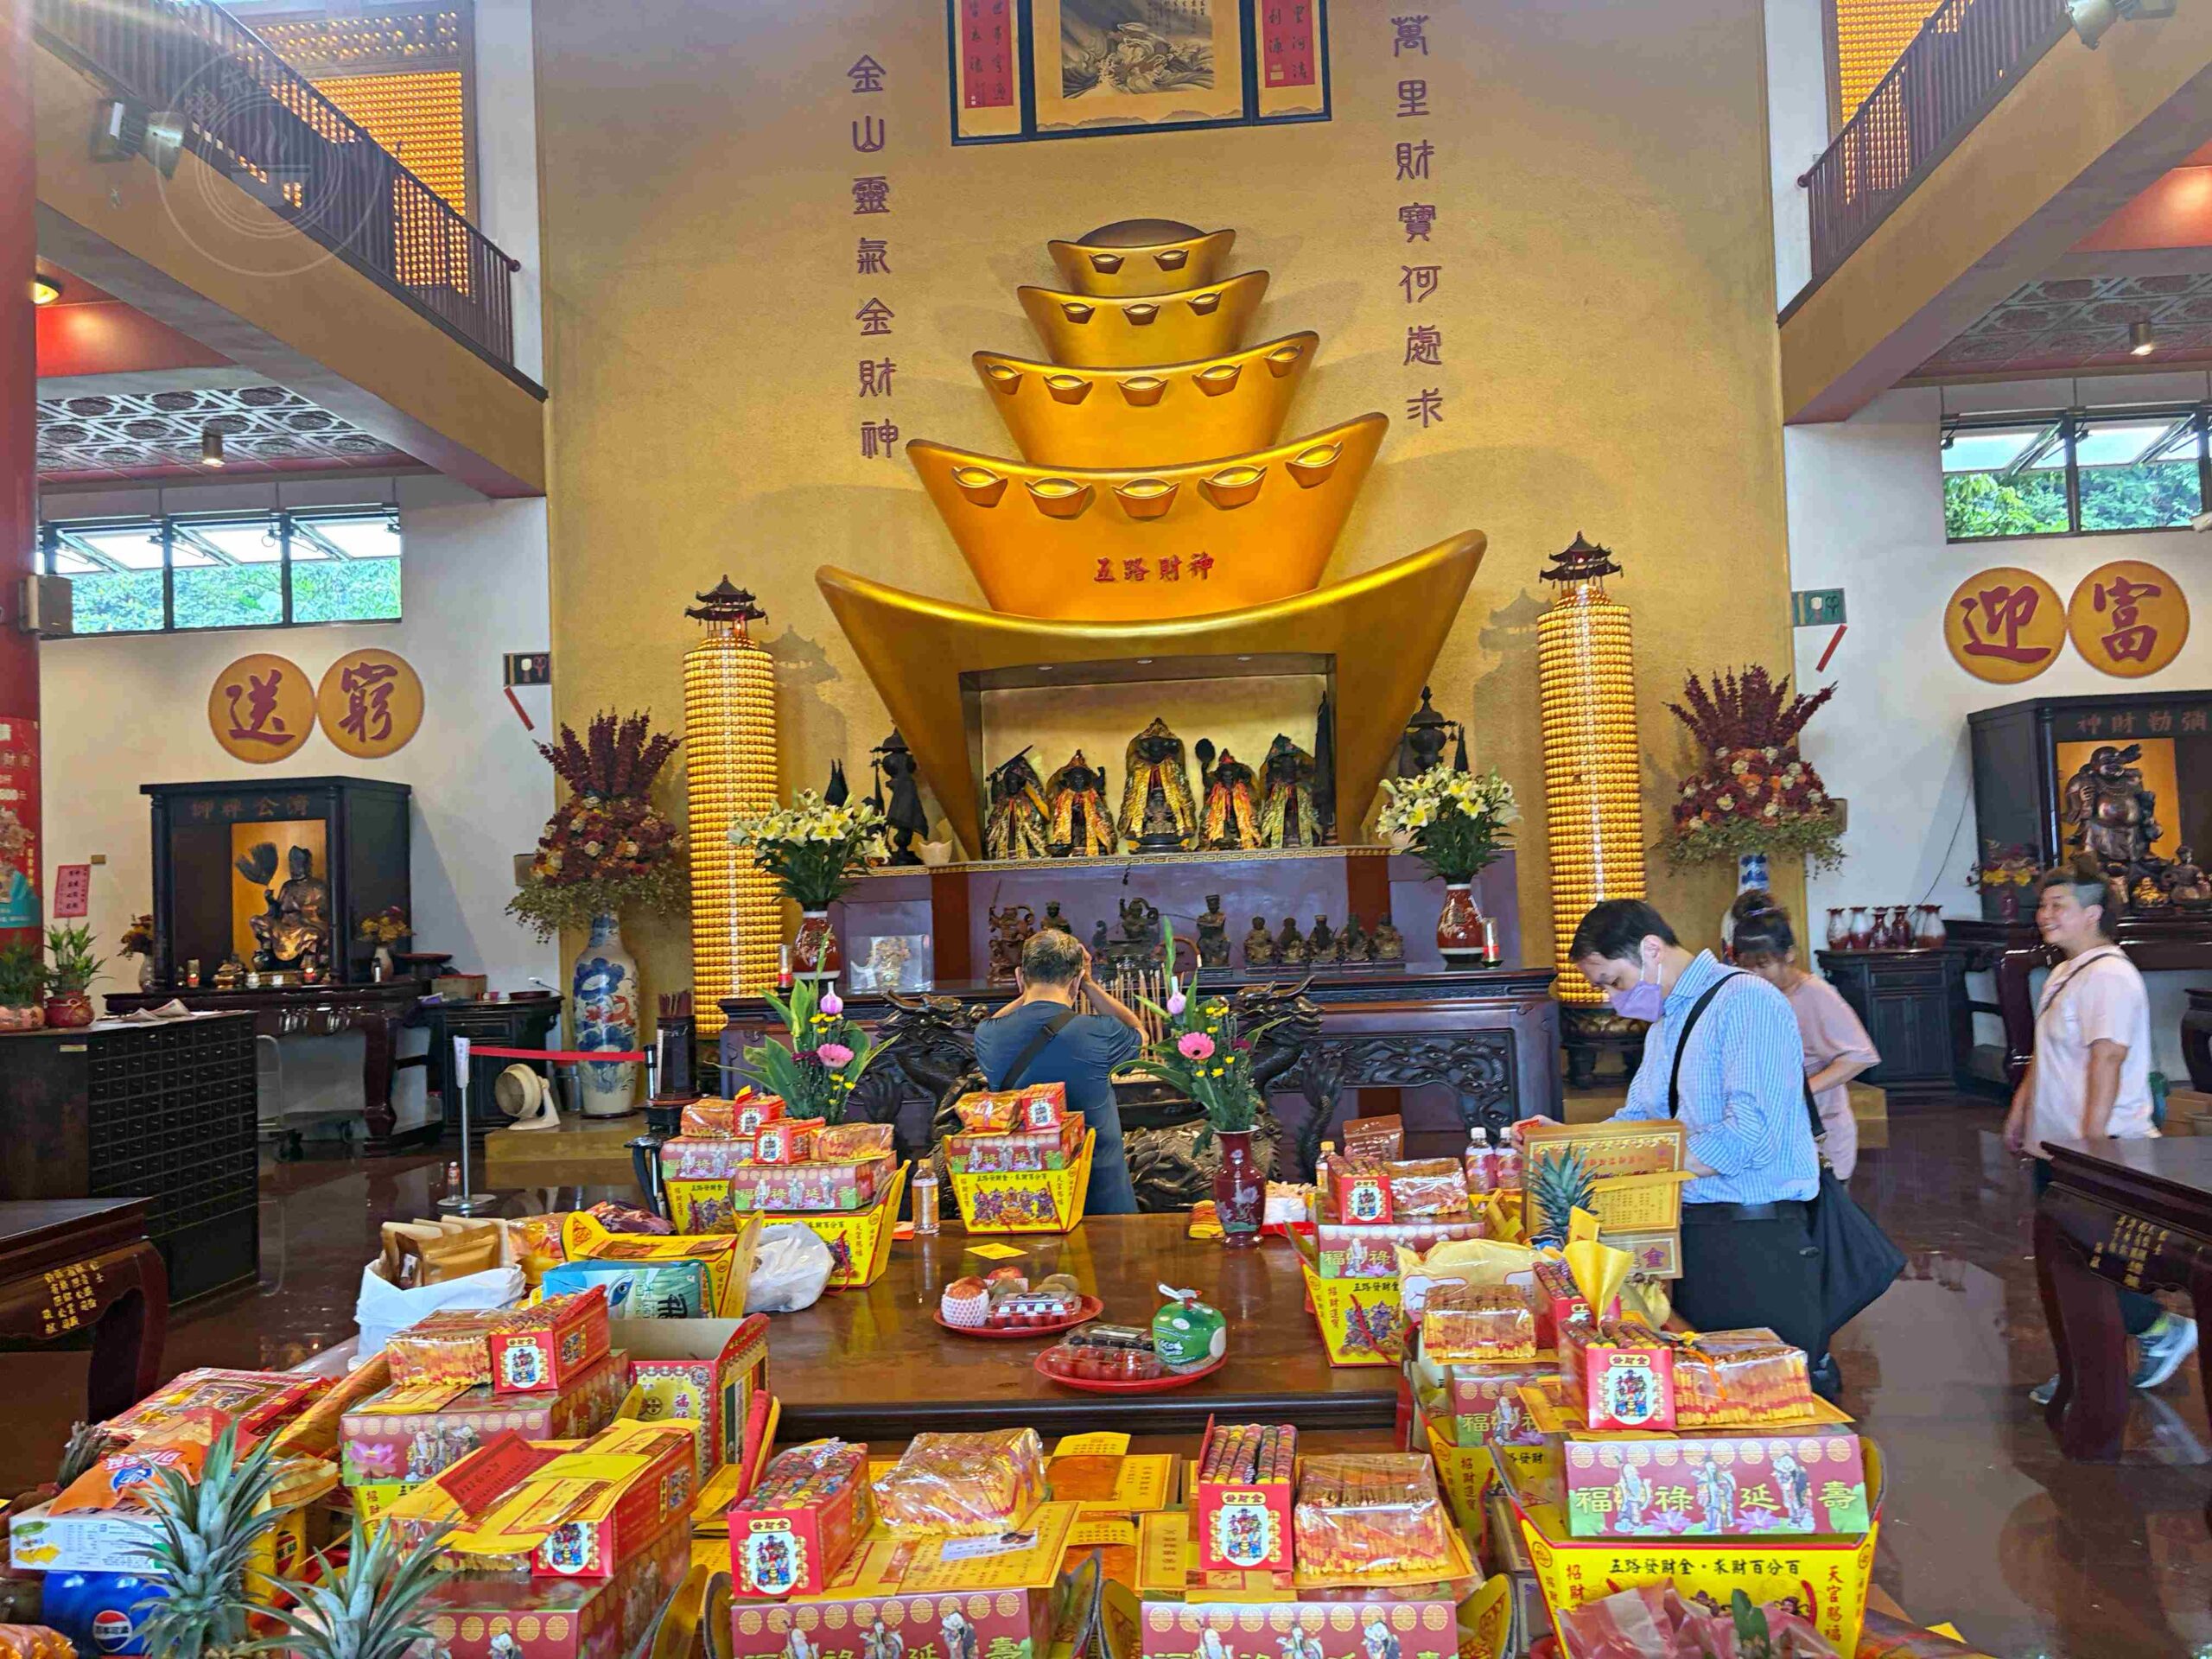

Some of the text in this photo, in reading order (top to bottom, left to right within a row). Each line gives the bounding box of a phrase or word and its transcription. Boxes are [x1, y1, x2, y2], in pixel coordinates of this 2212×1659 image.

[847, 54, 899, 460] 金山靈氣金財神
[1391, 16, 1443, 429] 萬里財寶何處求
[1093, 551, 1215, 582] 五路財神
[1576, 1481, 1857, 1513] 福祿延壽
[1825, 1566, 1845, 1643] 天官賜福
